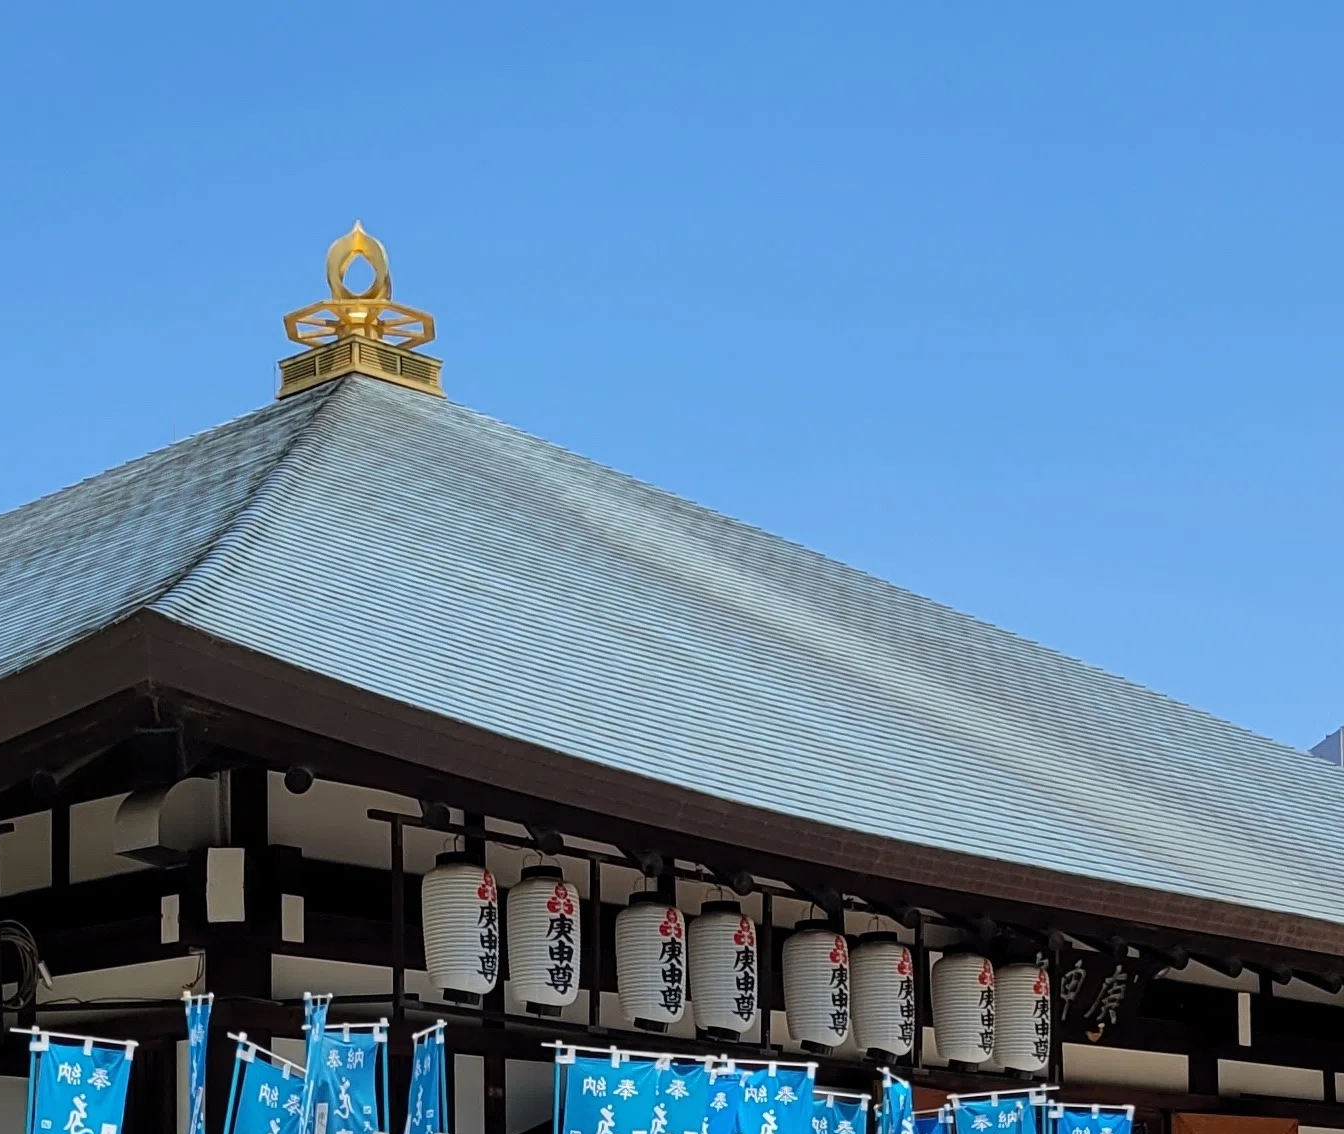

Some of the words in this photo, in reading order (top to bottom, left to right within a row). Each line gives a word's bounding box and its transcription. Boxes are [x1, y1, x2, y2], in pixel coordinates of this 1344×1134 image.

[477, 903, 499, 984] 庚申尊
[546, 913, 575, 995] 庚申尊
[658, 937, 683, 1017] 庚申尊
[731, 946, 756, 1023] 庚申尊
[828, 964, 850, 1037] 庚申尊
[896, 977, 914, 1048] 庚申尊
[977, 984, 996, 1055] 庚申尊
[327, 1049, 365, 1071] 奉納
[1032, 995, 1050, 1065] 庚申尊
[971, 1111, 1018, 1132] 奉納
